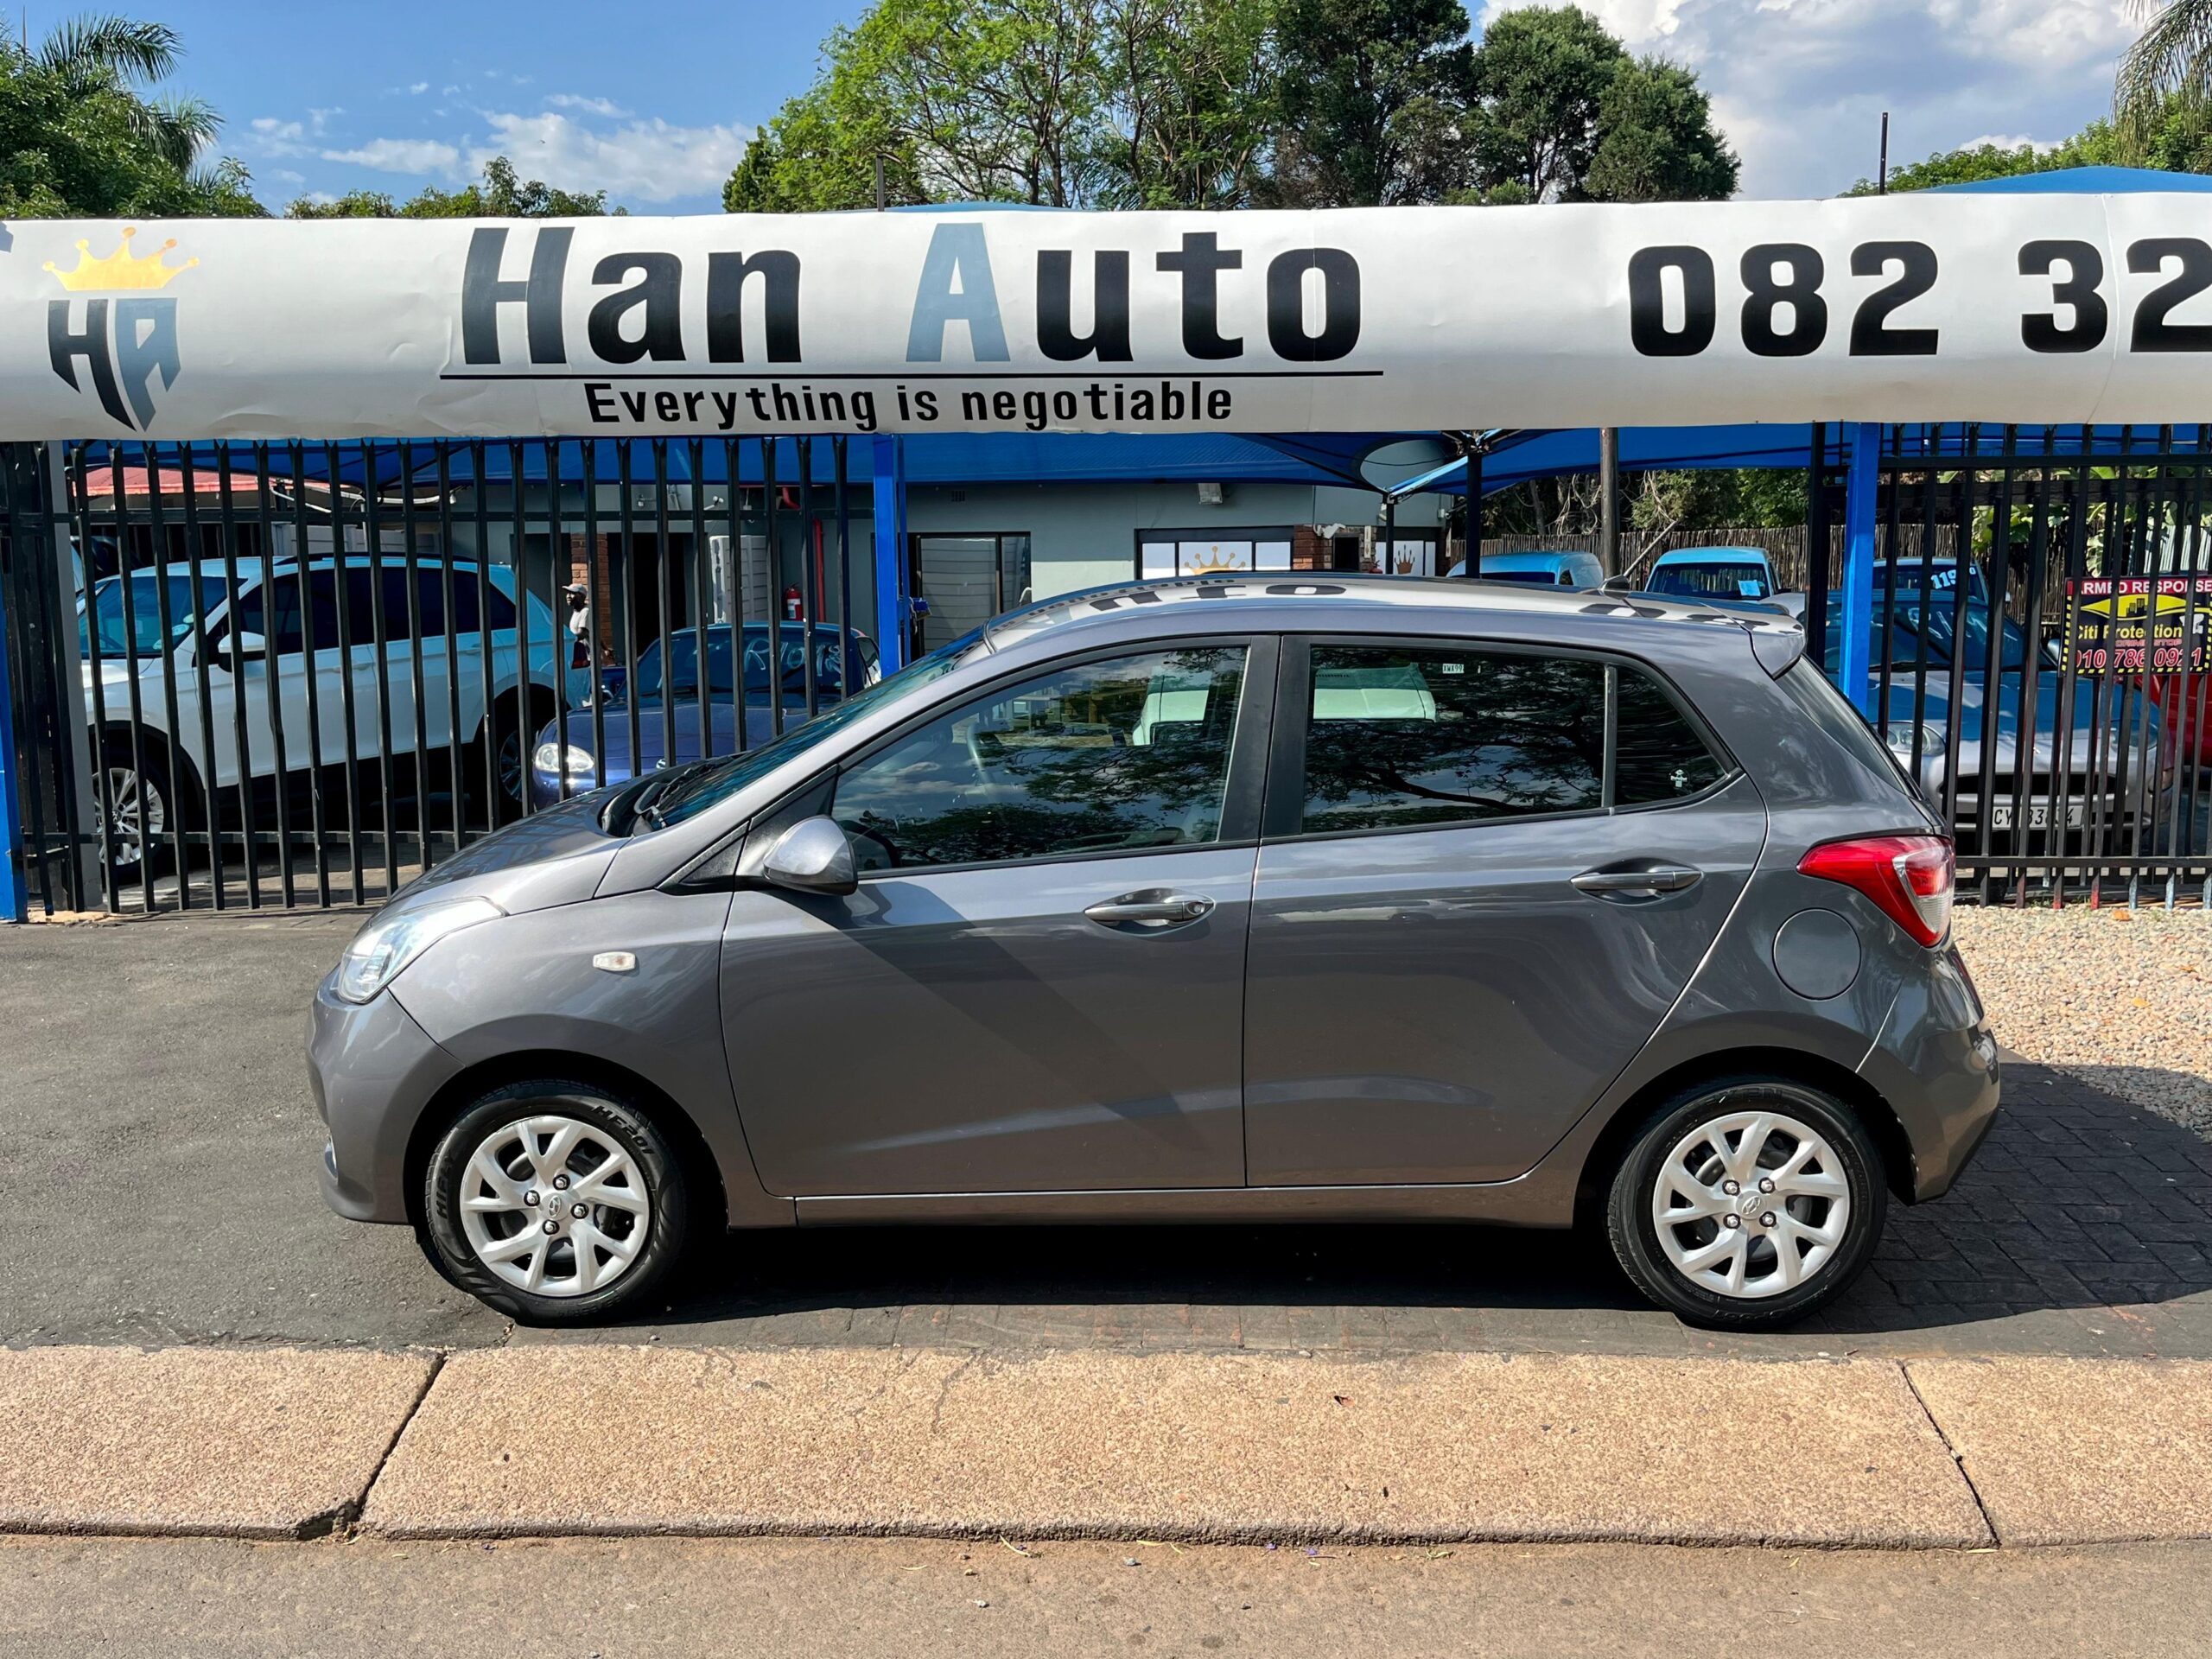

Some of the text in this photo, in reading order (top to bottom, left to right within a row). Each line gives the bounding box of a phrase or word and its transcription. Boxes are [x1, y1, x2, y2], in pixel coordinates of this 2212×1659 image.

[462, 222, 1362, 364] Han Auto
[1628, 238, 2212, 357] 082 32
[48, 297, 181, 432] HA
[584, 381, 1232, 431] Everything is negotiable
[2079, 582, 2128, 594] RMED
